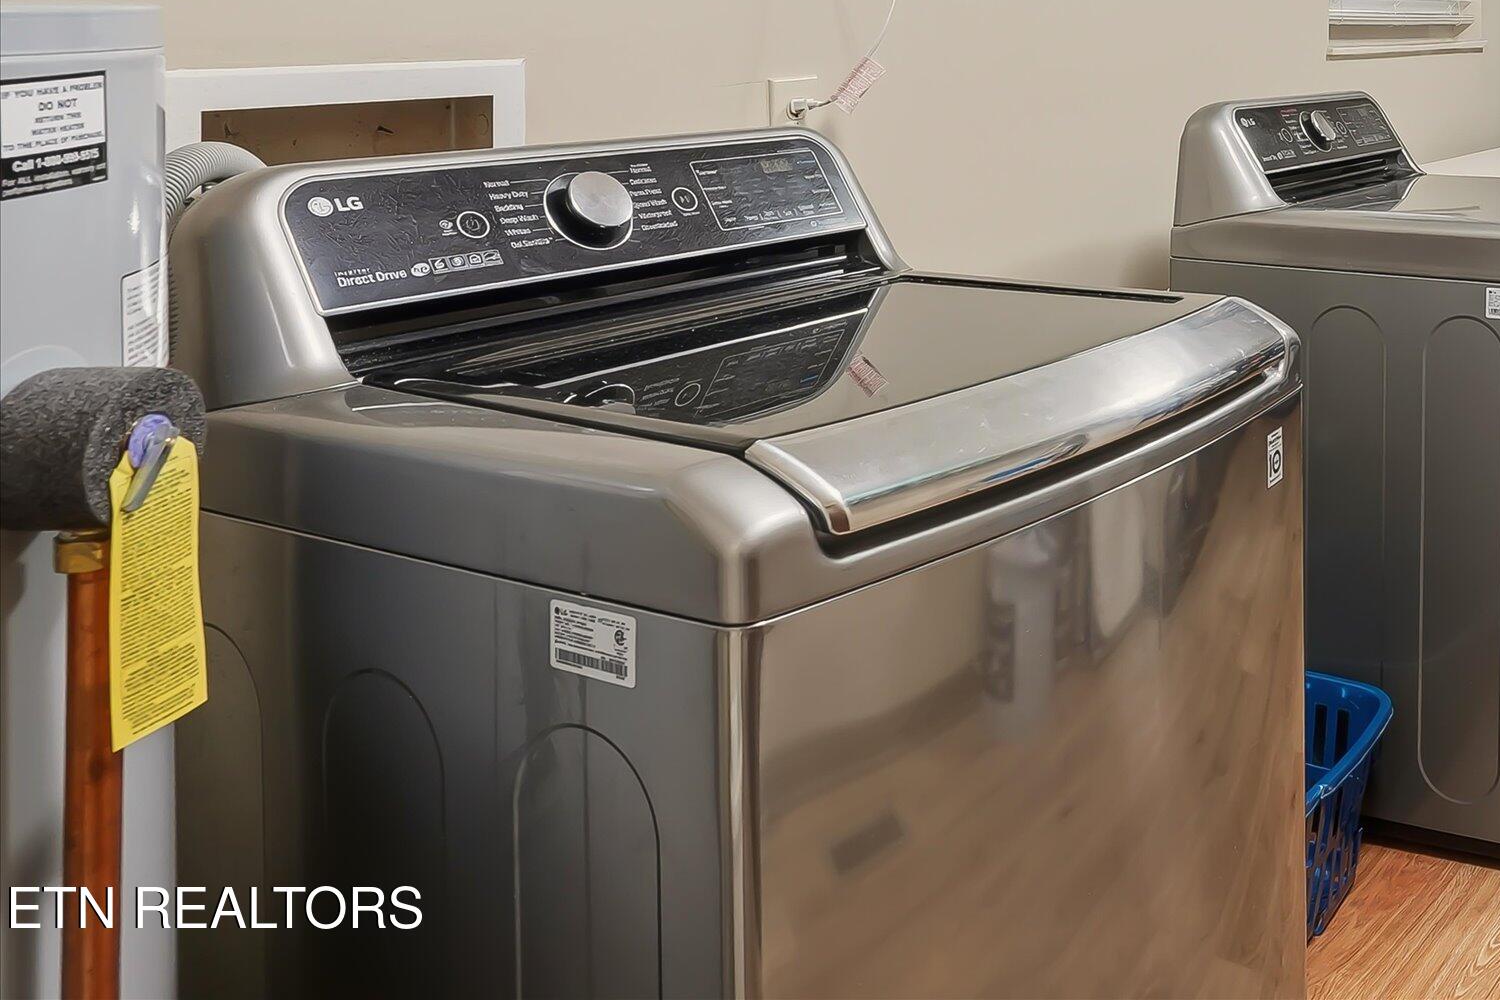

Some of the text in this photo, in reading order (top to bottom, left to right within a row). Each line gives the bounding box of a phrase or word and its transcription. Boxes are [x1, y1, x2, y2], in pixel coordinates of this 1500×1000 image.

[39, 98, 78, 111] DO NOT
[12, 159, 34, 172] Call
[334, 196, 364, 212] LG
[337, 269, 408, 288] Direct Drive
